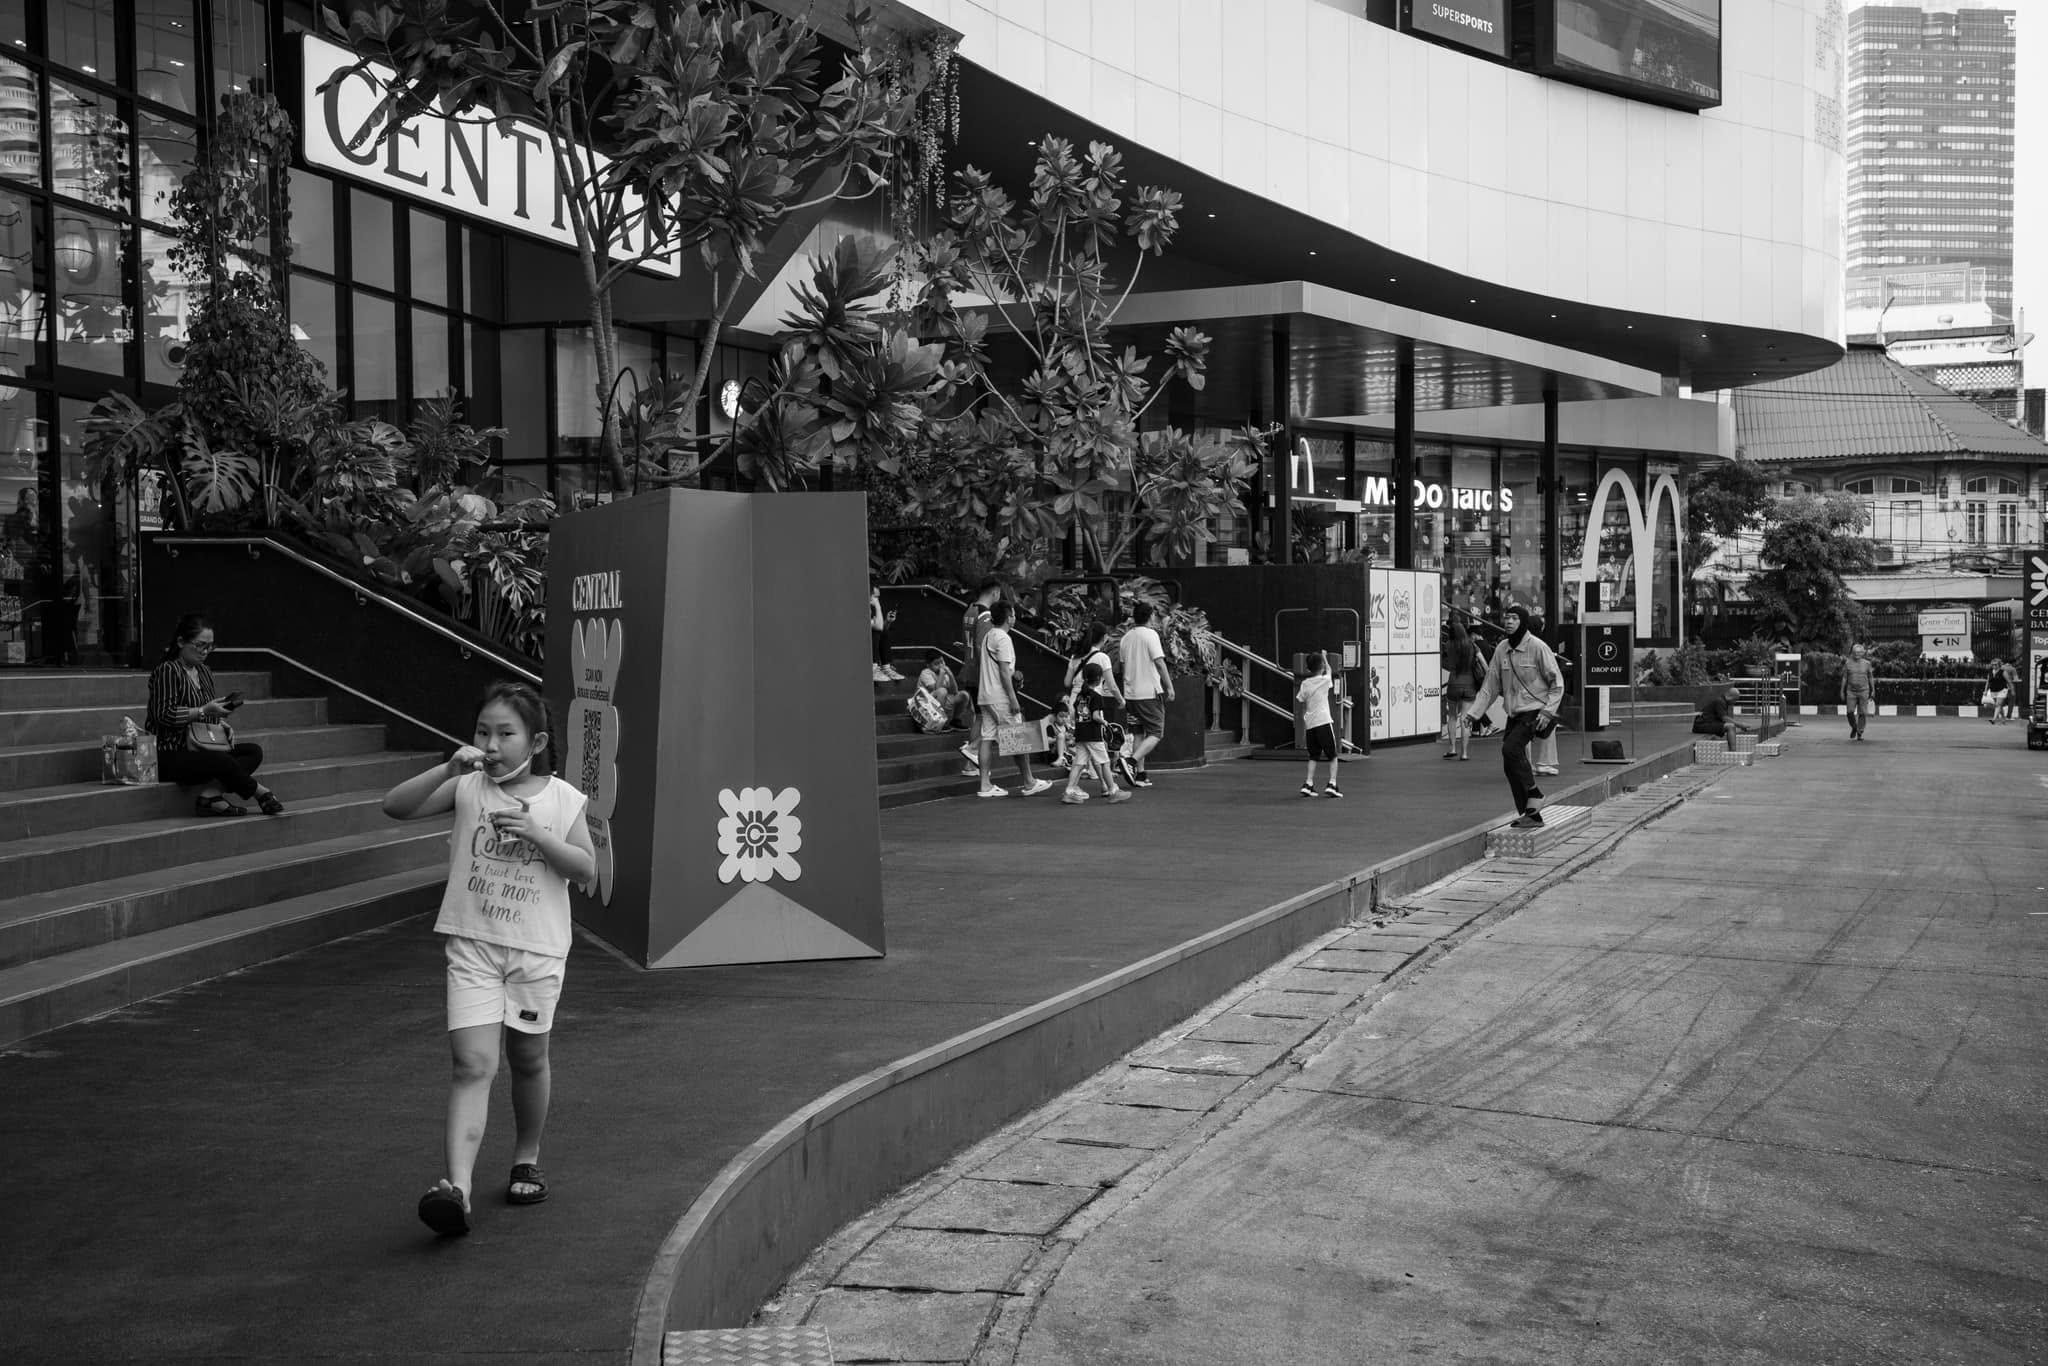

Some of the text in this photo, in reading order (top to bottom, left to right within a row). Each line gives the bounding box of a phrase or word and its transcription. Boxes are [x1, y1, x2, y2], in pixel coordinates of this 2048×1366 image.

[1432, 3, 1493, 34] SUPERSPORTS
[1364, 475, 1513, 512] MDonals
[572, 570, 623, 612] CENTRAL
[1604, 644, 1612, 656] P
[1947, 637, 1960, 646] IN
[470, 861, 535, 884] to trust love
[467, 875, 541, 905] one more
